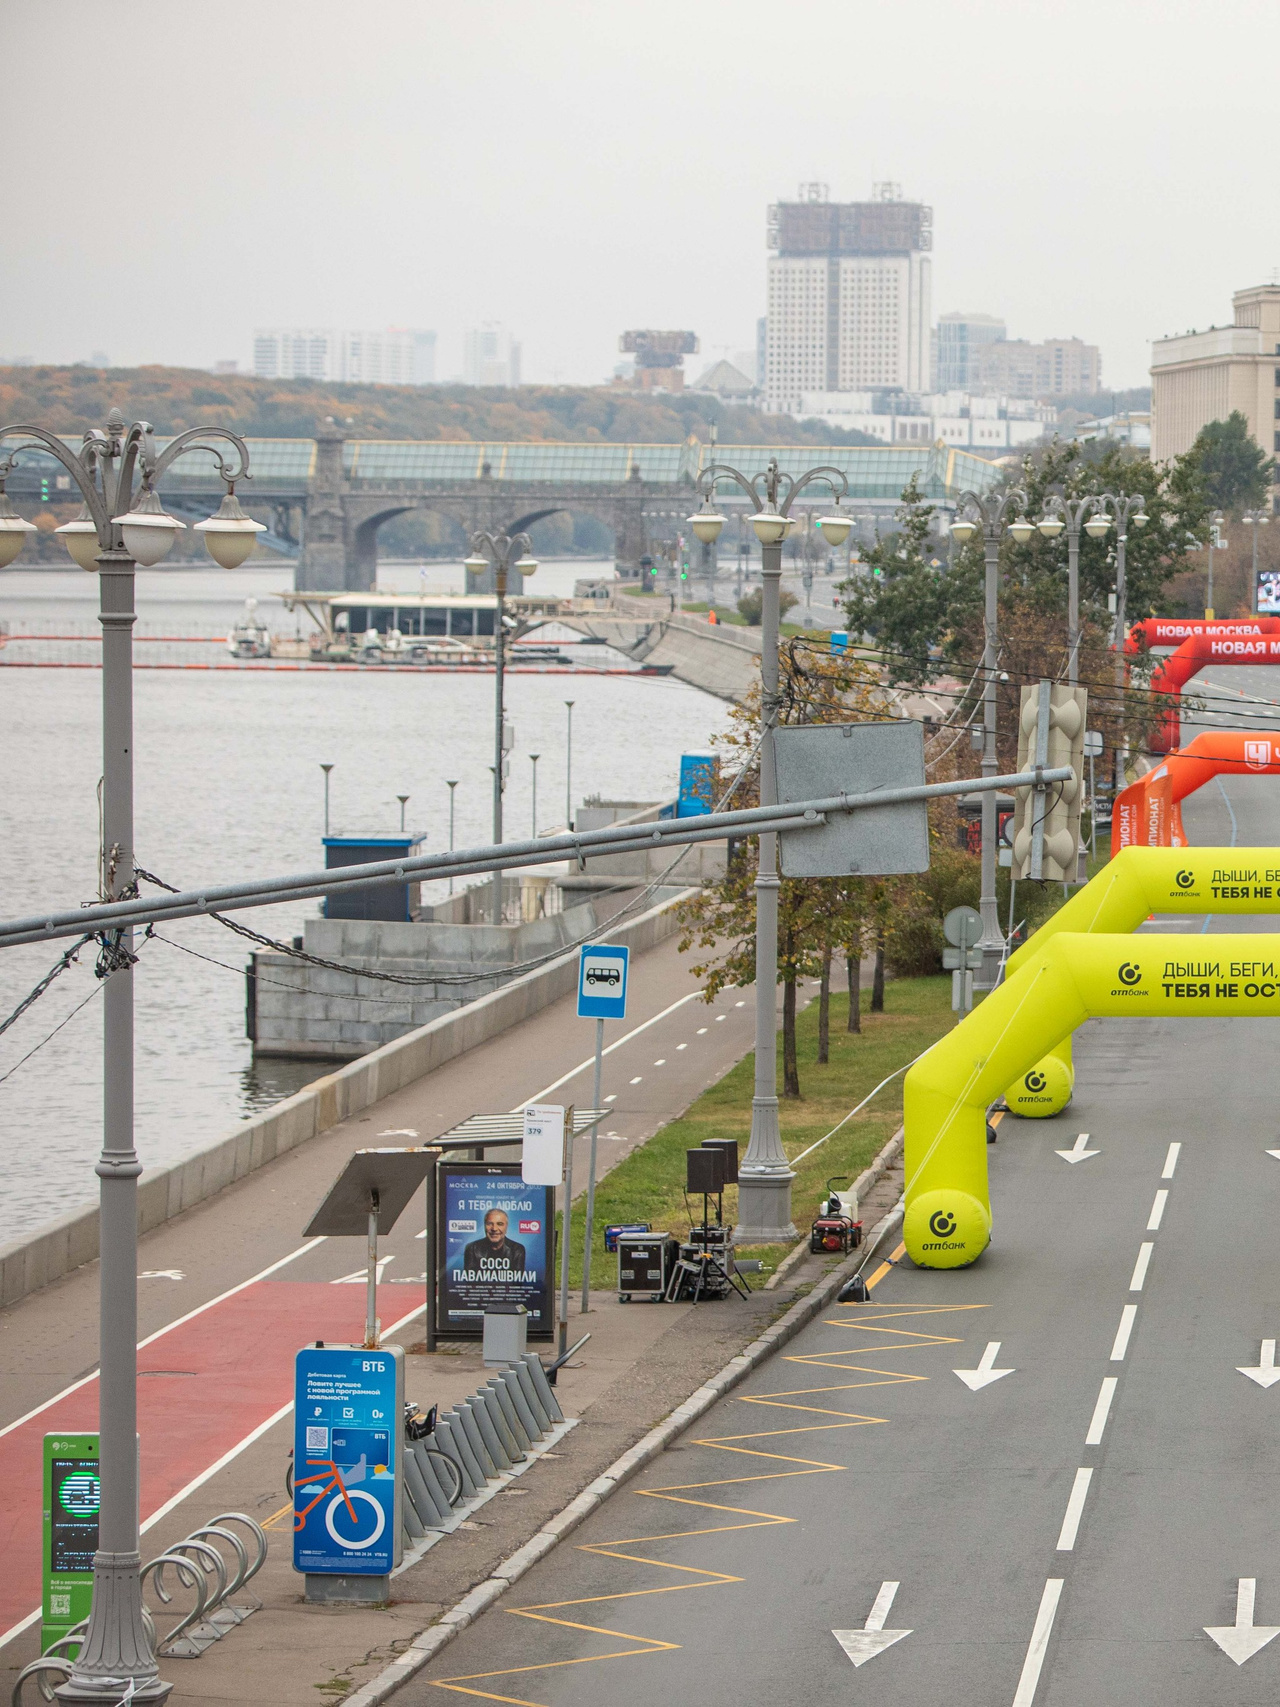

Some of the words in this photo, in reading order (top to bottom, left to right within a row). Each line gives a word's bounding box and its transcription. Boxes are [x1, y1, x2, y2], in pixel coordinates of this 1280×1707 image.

[1156, 624, 1203, 637] НОВАЯ
[1205, 624, 1262, 635] МОСКВА
[1211, 641, 1267, 655] НОВАЯ
[1212, 869, 1262, 883] ДЫШИ,
[1210, 886, 1250, 898] ТЕБЯ
[1254, 886, 1272, 898] НЕ
[1162, 962, 1225, 979] ДЫШИ,
[1230, 962, 1278, 978] БЕГИ,
[1162, 983, 1210, 998] ТЕБЯ
[1215, 983, 1238, 998] НЕ
[458, 1200, 465, 1210] Я
[468, 1200, 492, 1210] ТЕБЯ
[496, 1201, 532, 1211] ЛЮБЛЮ
[480, 1258, 510, 1269] СОСО
[453, 1270, 536, 1282] ПАВЛИАШВИЛИ
[362, 1361, 386, 1372] ВТБ
